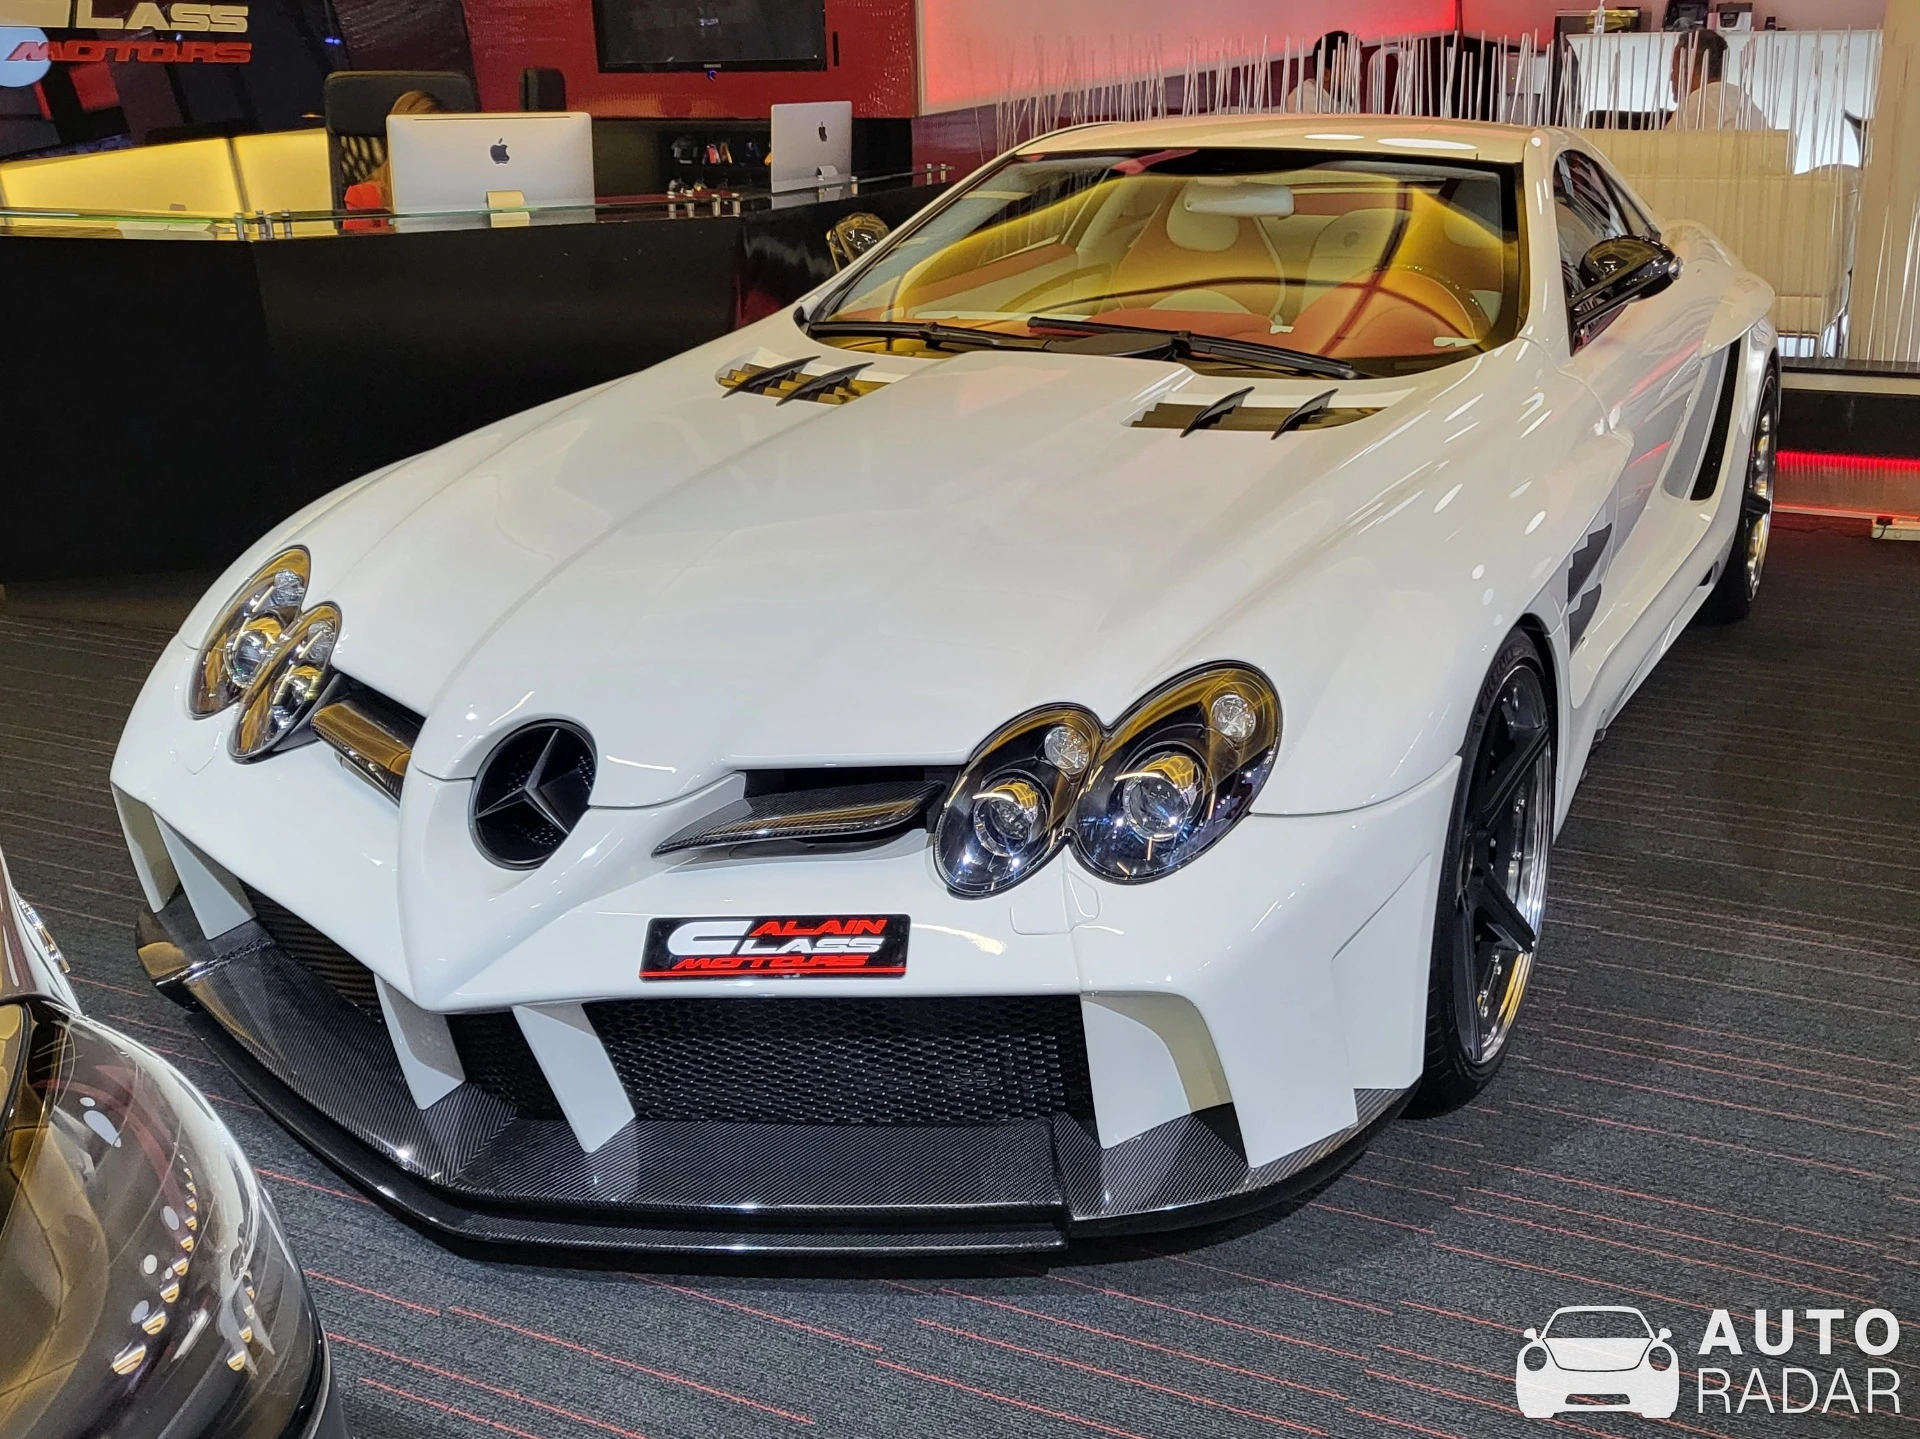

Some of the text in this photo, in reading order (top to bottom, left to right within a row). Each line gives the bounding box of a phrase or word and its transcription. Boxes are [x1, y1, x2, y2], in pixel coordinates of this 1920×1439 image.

[5, 40, 252, 62] MOTORS
[749, 919, 887, 936] ALAIN
[667, 920, 884, 955] CLASS
[672, 955, 869, 970] MOTORS
